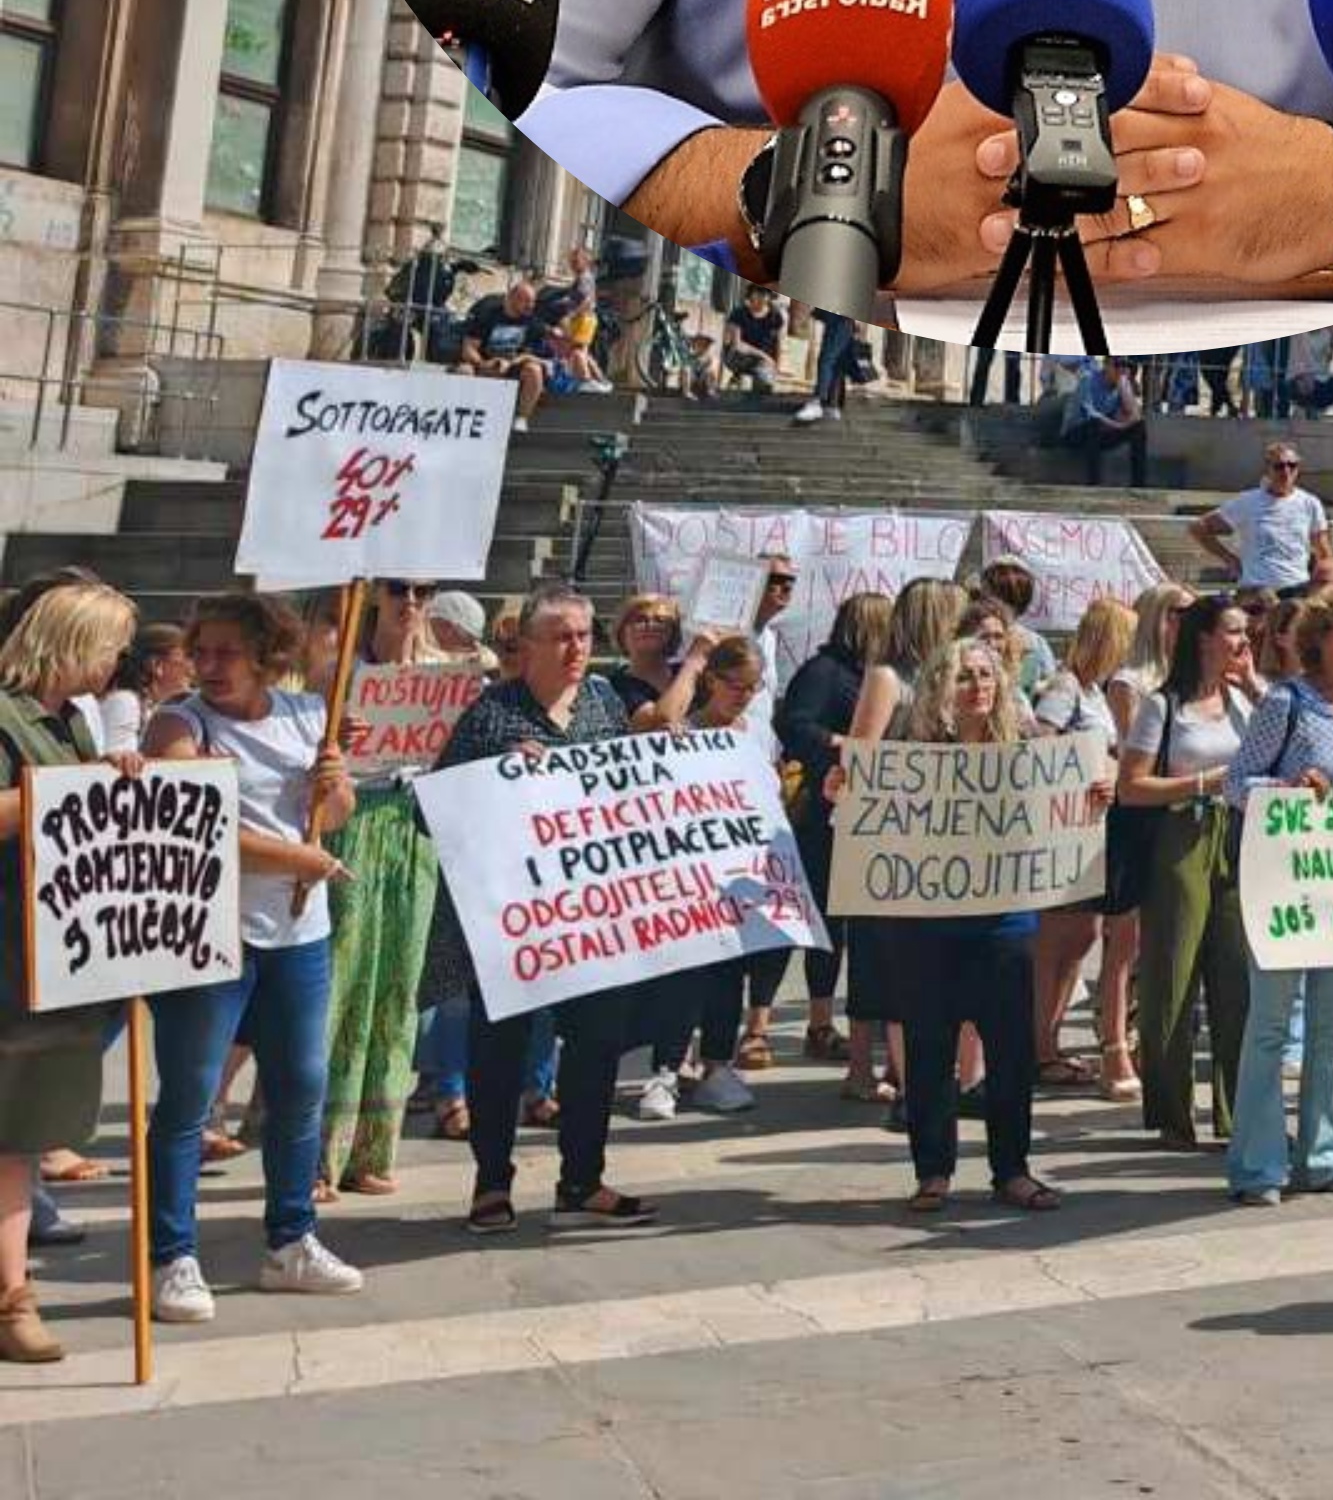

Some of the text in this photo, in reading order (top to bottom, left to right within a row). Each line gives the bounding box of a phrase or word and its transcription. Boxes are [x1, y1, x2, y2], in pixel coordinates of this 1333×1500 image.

[286, 390, 486, 439] SOTTOPAGATE
[321, 493, 400, 540] 29%
[497, 740, 641, 782] GRADSKI
[580, 762, 674, 797] PULA
[846, 743, 1084, 793] NESTRUČNA
[532, 779, 756, 847] DEFICITARNE
[851, 798, 1033, 837] ZAMJENA
[1265, 798, 1311, 836] SVE
[525, 815, 771, 886] I POTPLAĆENE
[864, 845, 1083, 902] ODGOJITELJ
[501, 862, 716, 938] ODGOJITELJI
[1268, 894, 1316, 938] JOŠ
[63, 916, 91, 975] S
[513, 923, 626, 982] OSTALI
